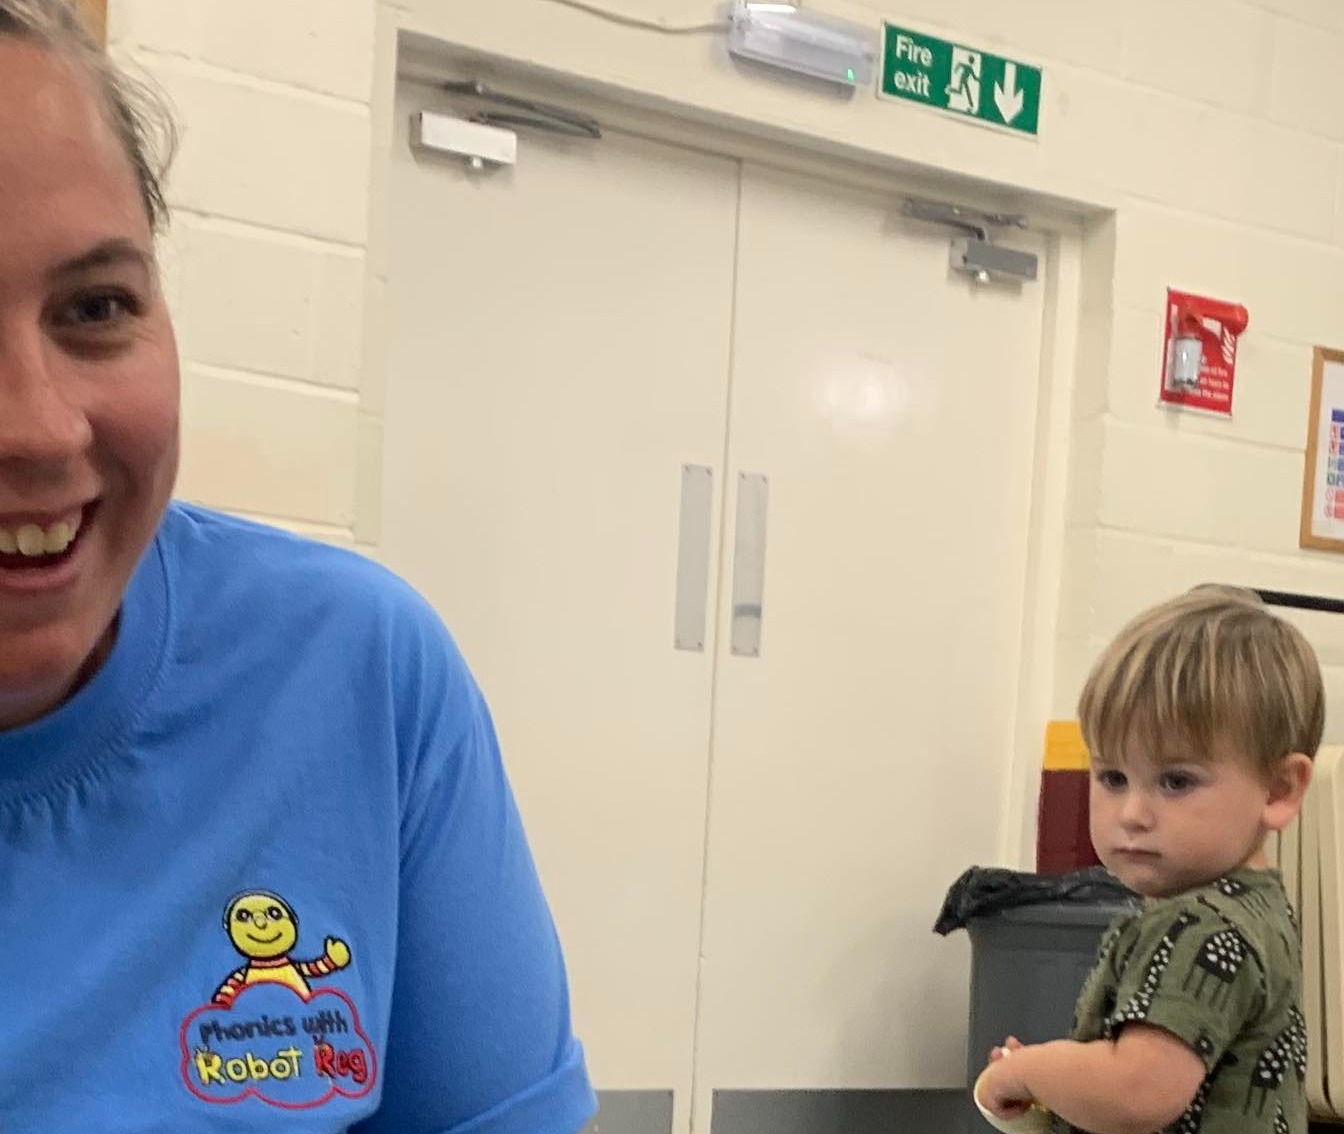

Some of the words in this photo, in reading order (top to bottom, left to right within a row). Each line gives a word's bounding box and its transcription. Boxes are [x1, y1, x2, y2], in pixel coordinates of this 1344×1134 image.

[895, 34, 933, 67] Fire
[893, 69, 931, 98] exit
[313, 1039, 369, 1084] Reg
